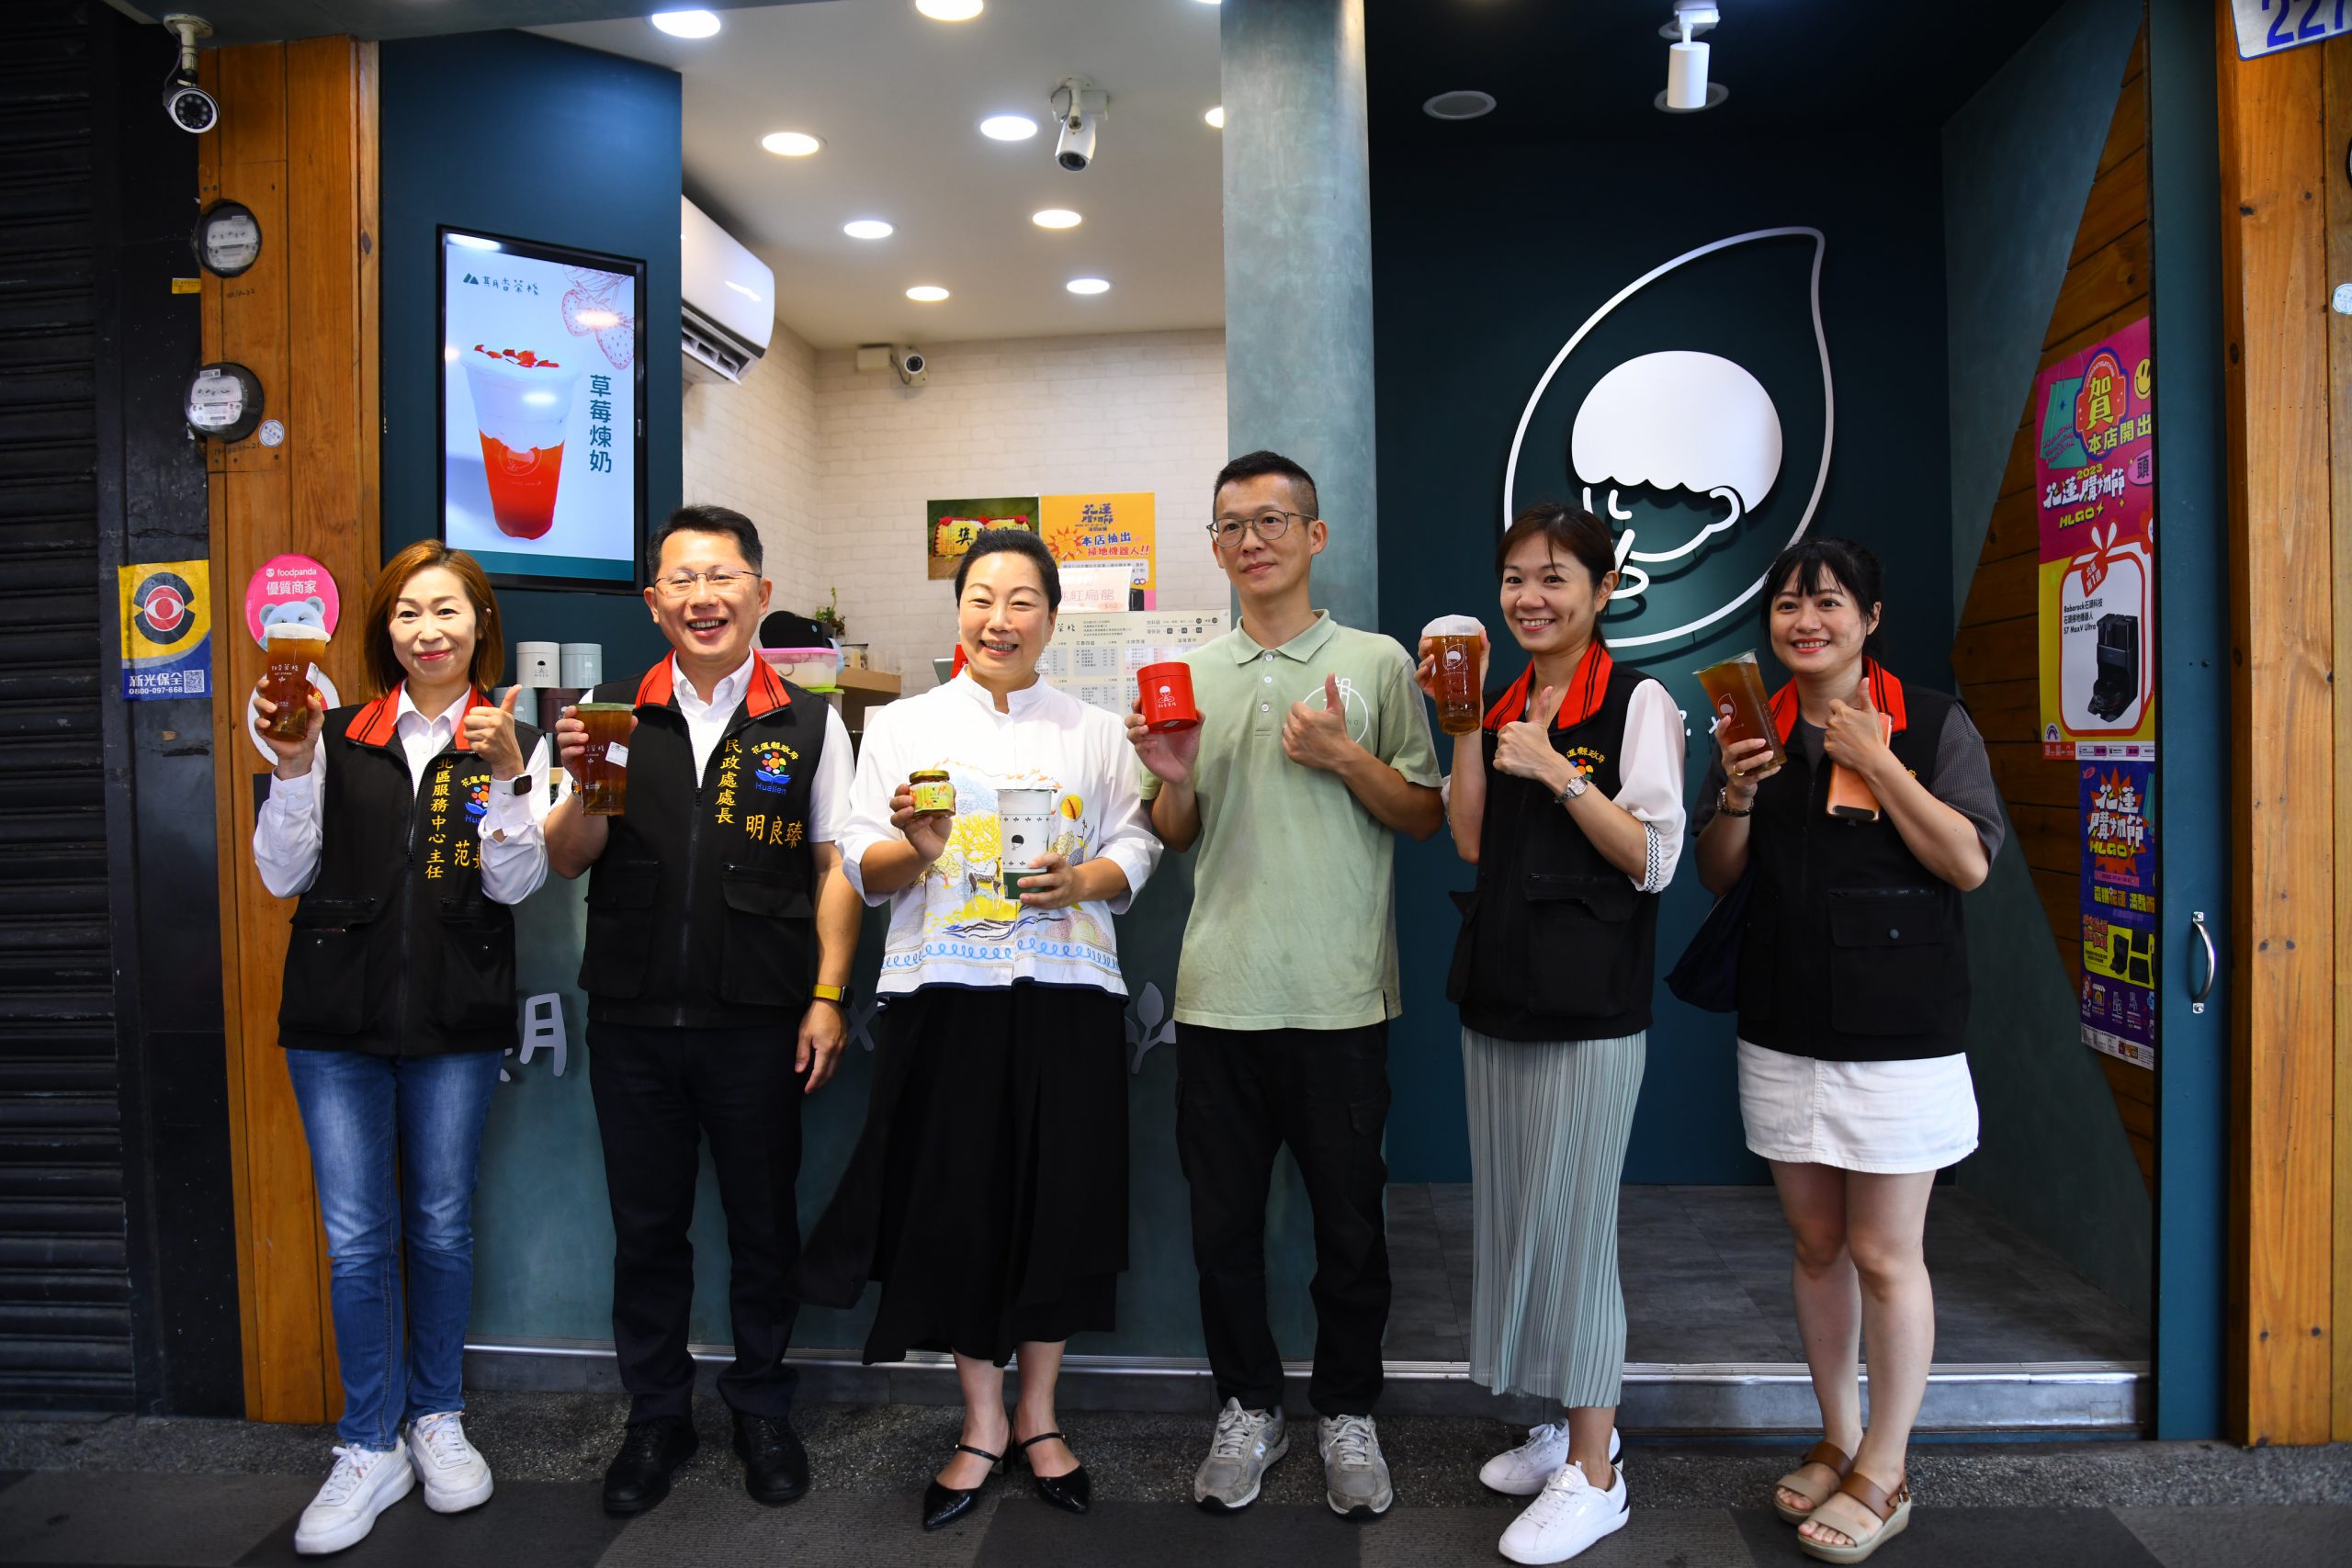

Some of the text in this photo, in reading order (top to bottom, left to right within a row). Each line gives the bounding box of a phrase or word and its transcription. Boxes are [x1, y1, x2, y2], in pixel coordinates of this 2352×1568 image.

[2086, 375, 2114, 430] 賀
[590, 374, 612, 473] 草莓煉奶
[2087, 413, 2152, 456] 本店開出
[2076, 463, 2103, 479] 2023
[2042, 467, 2126, 510] 花蓮購物節
[1081, 502, 1113, 514] 花蓮
[2058, 504, 2095, 529] HLGO
[1081, 531, 1132, 547] 本店抽出
[277, 567, 317, 577] foodpanda
[266, 580, 317, 596] 優質商家
[128, 686, 183, 694] 0800-097-668
[129, 672, 183, 687] 新光保全
[715, 739, 743, 824] 民政處處長
[755, 781, 786, 795] Hualien
[2094, 784, 2140, 815] 花蓮
[424, 758, 454, 879] 北區服務中心主任
[745, 814, 803, 849] 明良臻
[2086, 811, 2144, 852] 購物節
[2088, 840, 2128, 858] HLGO
